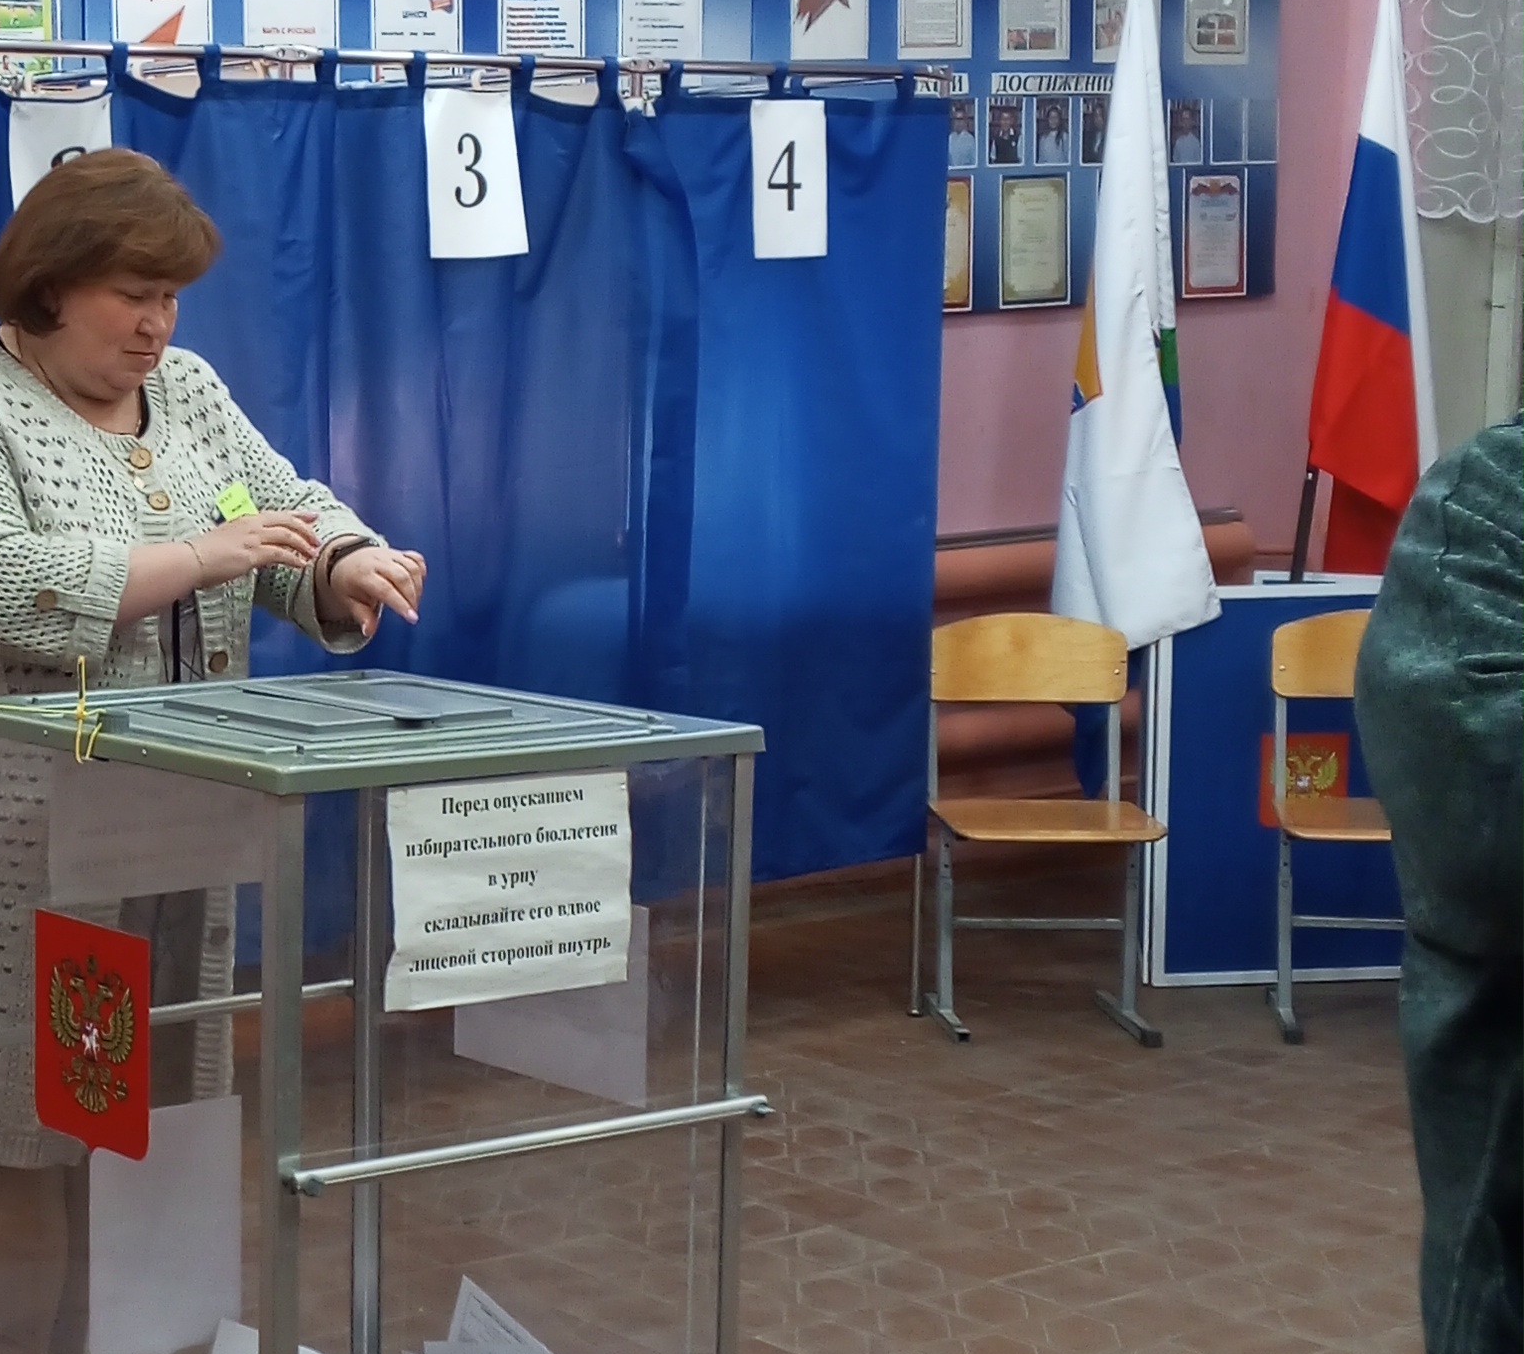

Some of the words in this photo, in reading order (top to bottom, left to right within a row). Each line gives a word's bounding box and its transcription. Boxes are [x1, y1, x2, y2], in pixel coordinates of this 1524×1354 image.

[454, 133, 488, 208] 3
[767, 141, 802, 212] 4
[441, 797, 490, 817] Перед
[493, 789, 584, 813] опусканием
[405, 830, 532, 858] избирательного
[536, 823, 618, 844] бюллетеня
[488, 873, 497, 886] в
[501, 868, 539, 890] урну
[424, 906, 526, 934] складывайте
[529, 905, 554, 921] его
[558, 899, 601, 918] вдвое
[409, 949, 477, 973] лицевой
[481, 940, 554, 966] стороной
[558, 935, 612, 957] внутрь
